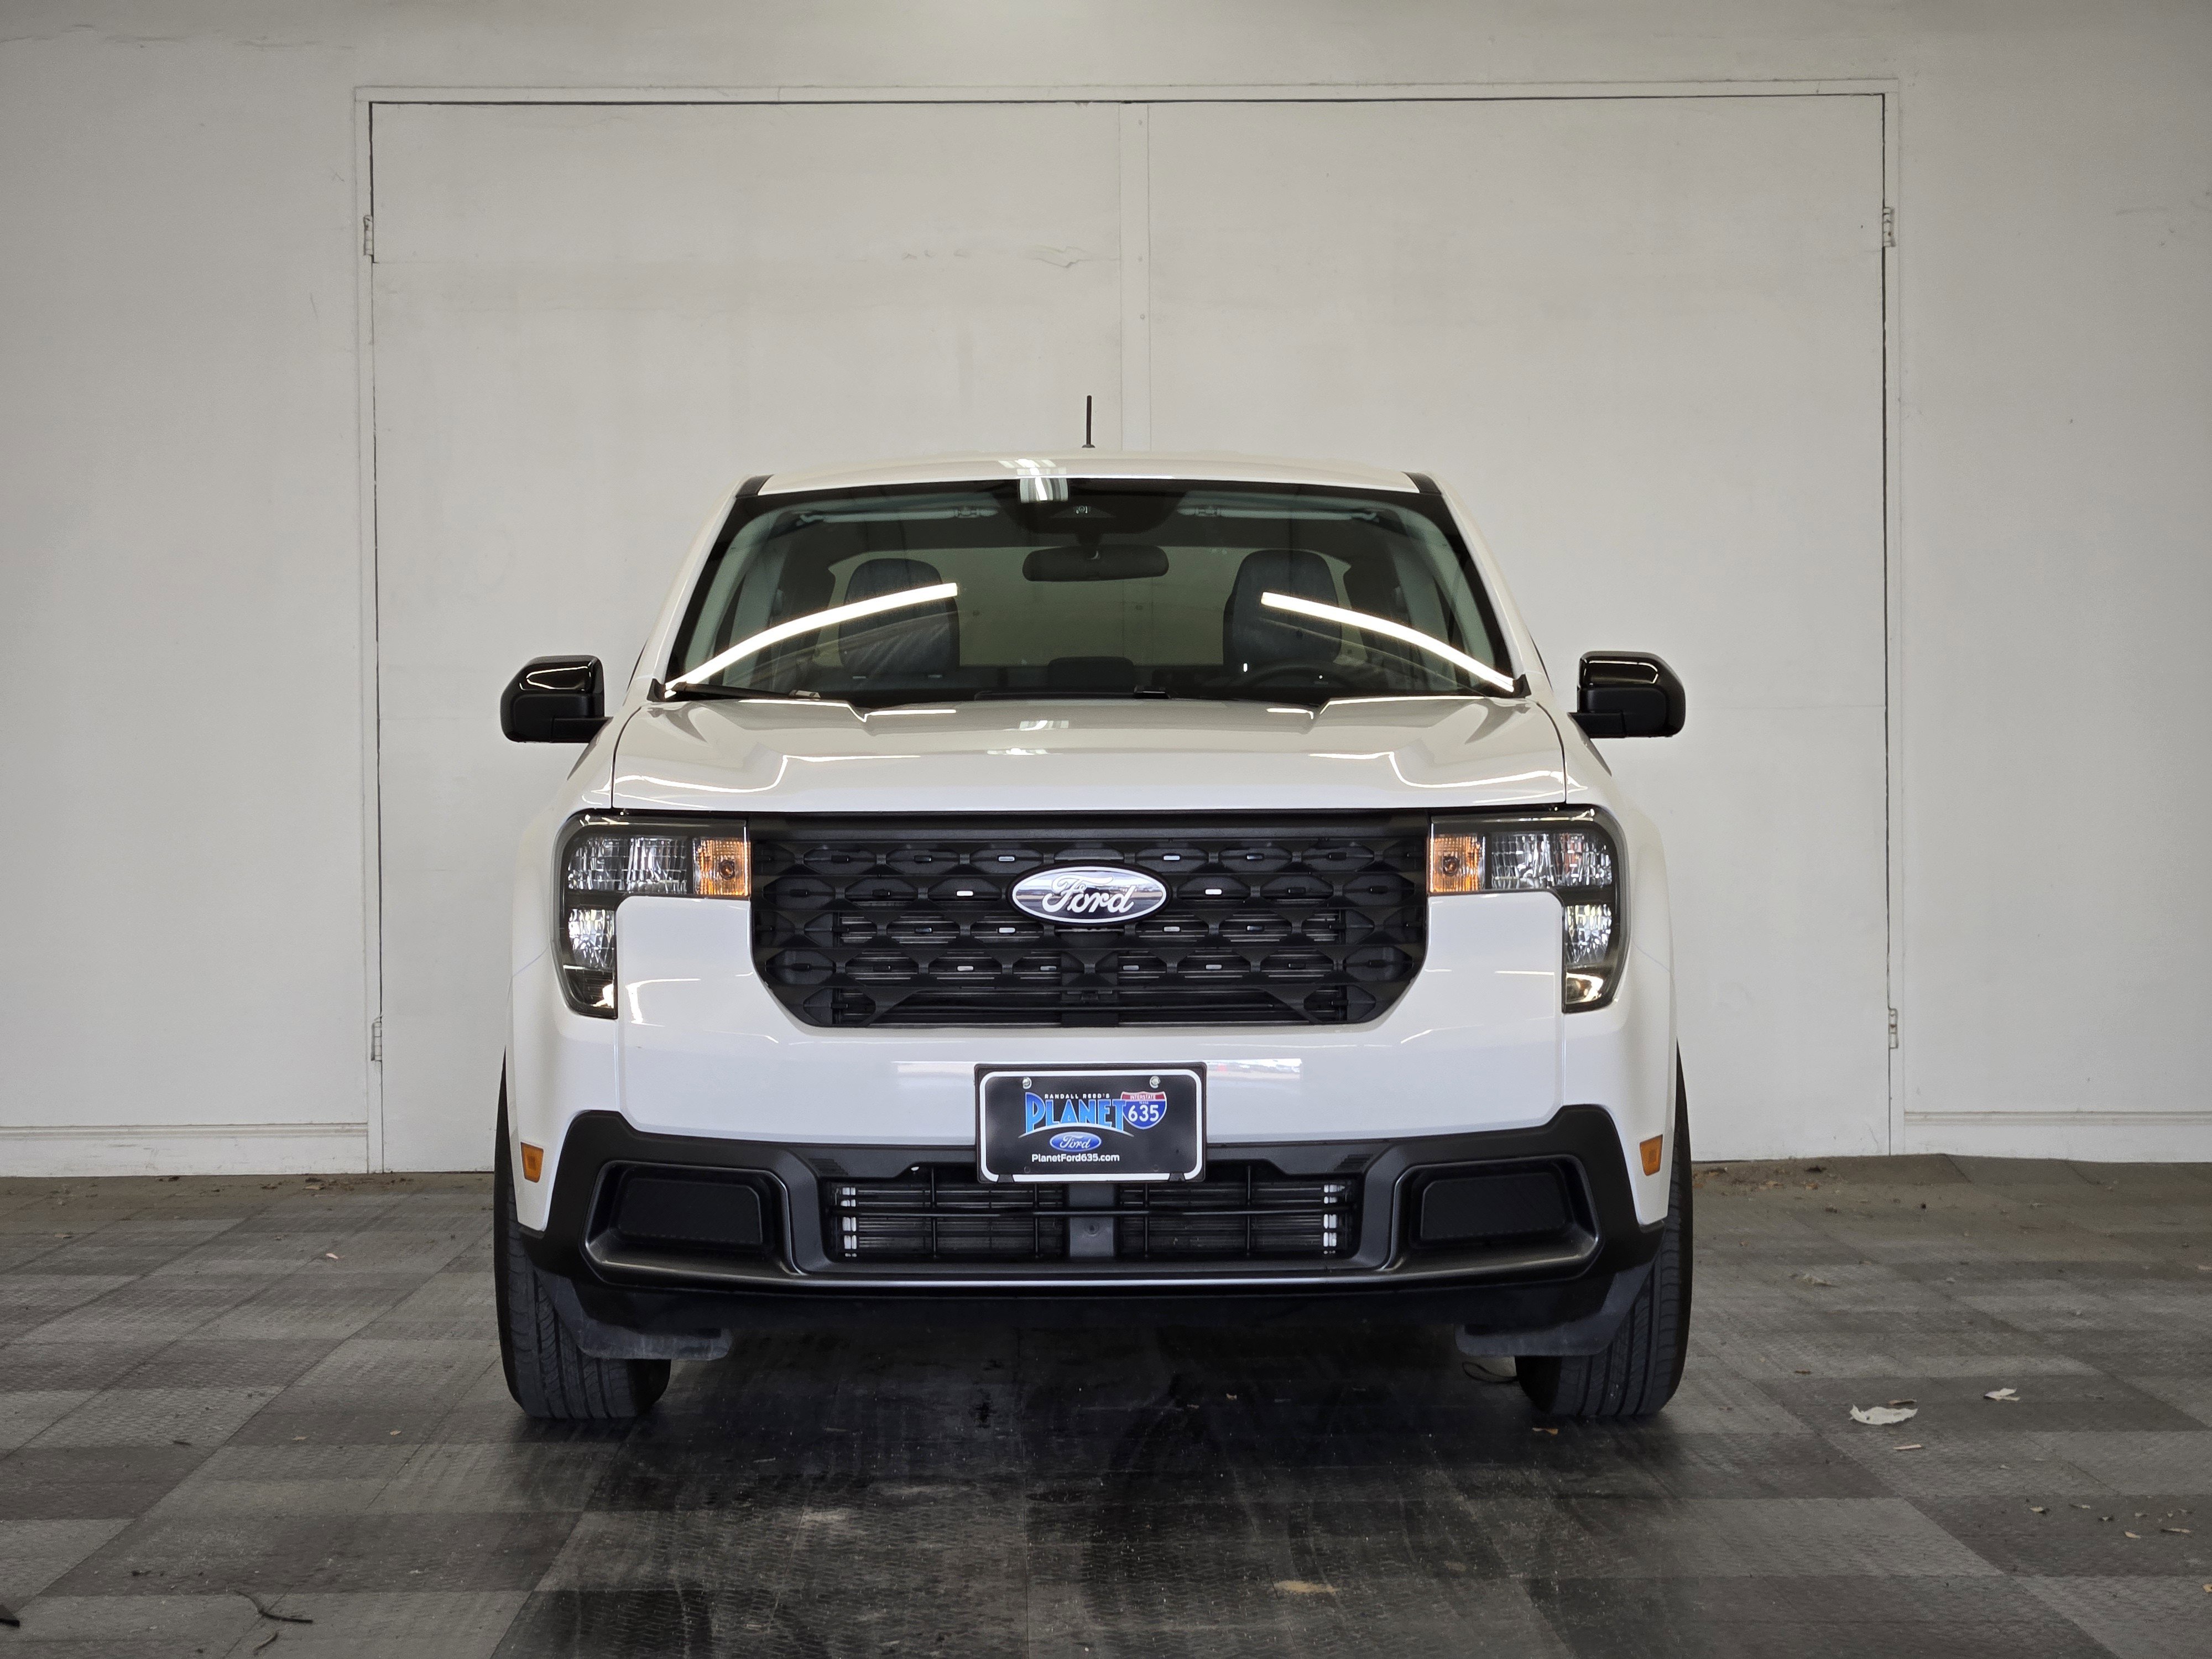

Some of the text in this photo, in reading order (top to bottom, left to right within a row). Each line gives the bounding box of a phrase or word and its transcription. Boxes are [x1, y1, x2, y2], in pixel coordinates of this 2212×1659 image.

[1042, 874, 1136, 912] Ford
[1025, 1092, 1127, 1134] PLANET
[1128, 1104, 1159, 1122] 635
[1060, 1135, 1091, 1149] Ford
[1031, 1153, 1120, 1162] PlanetFord635.com
